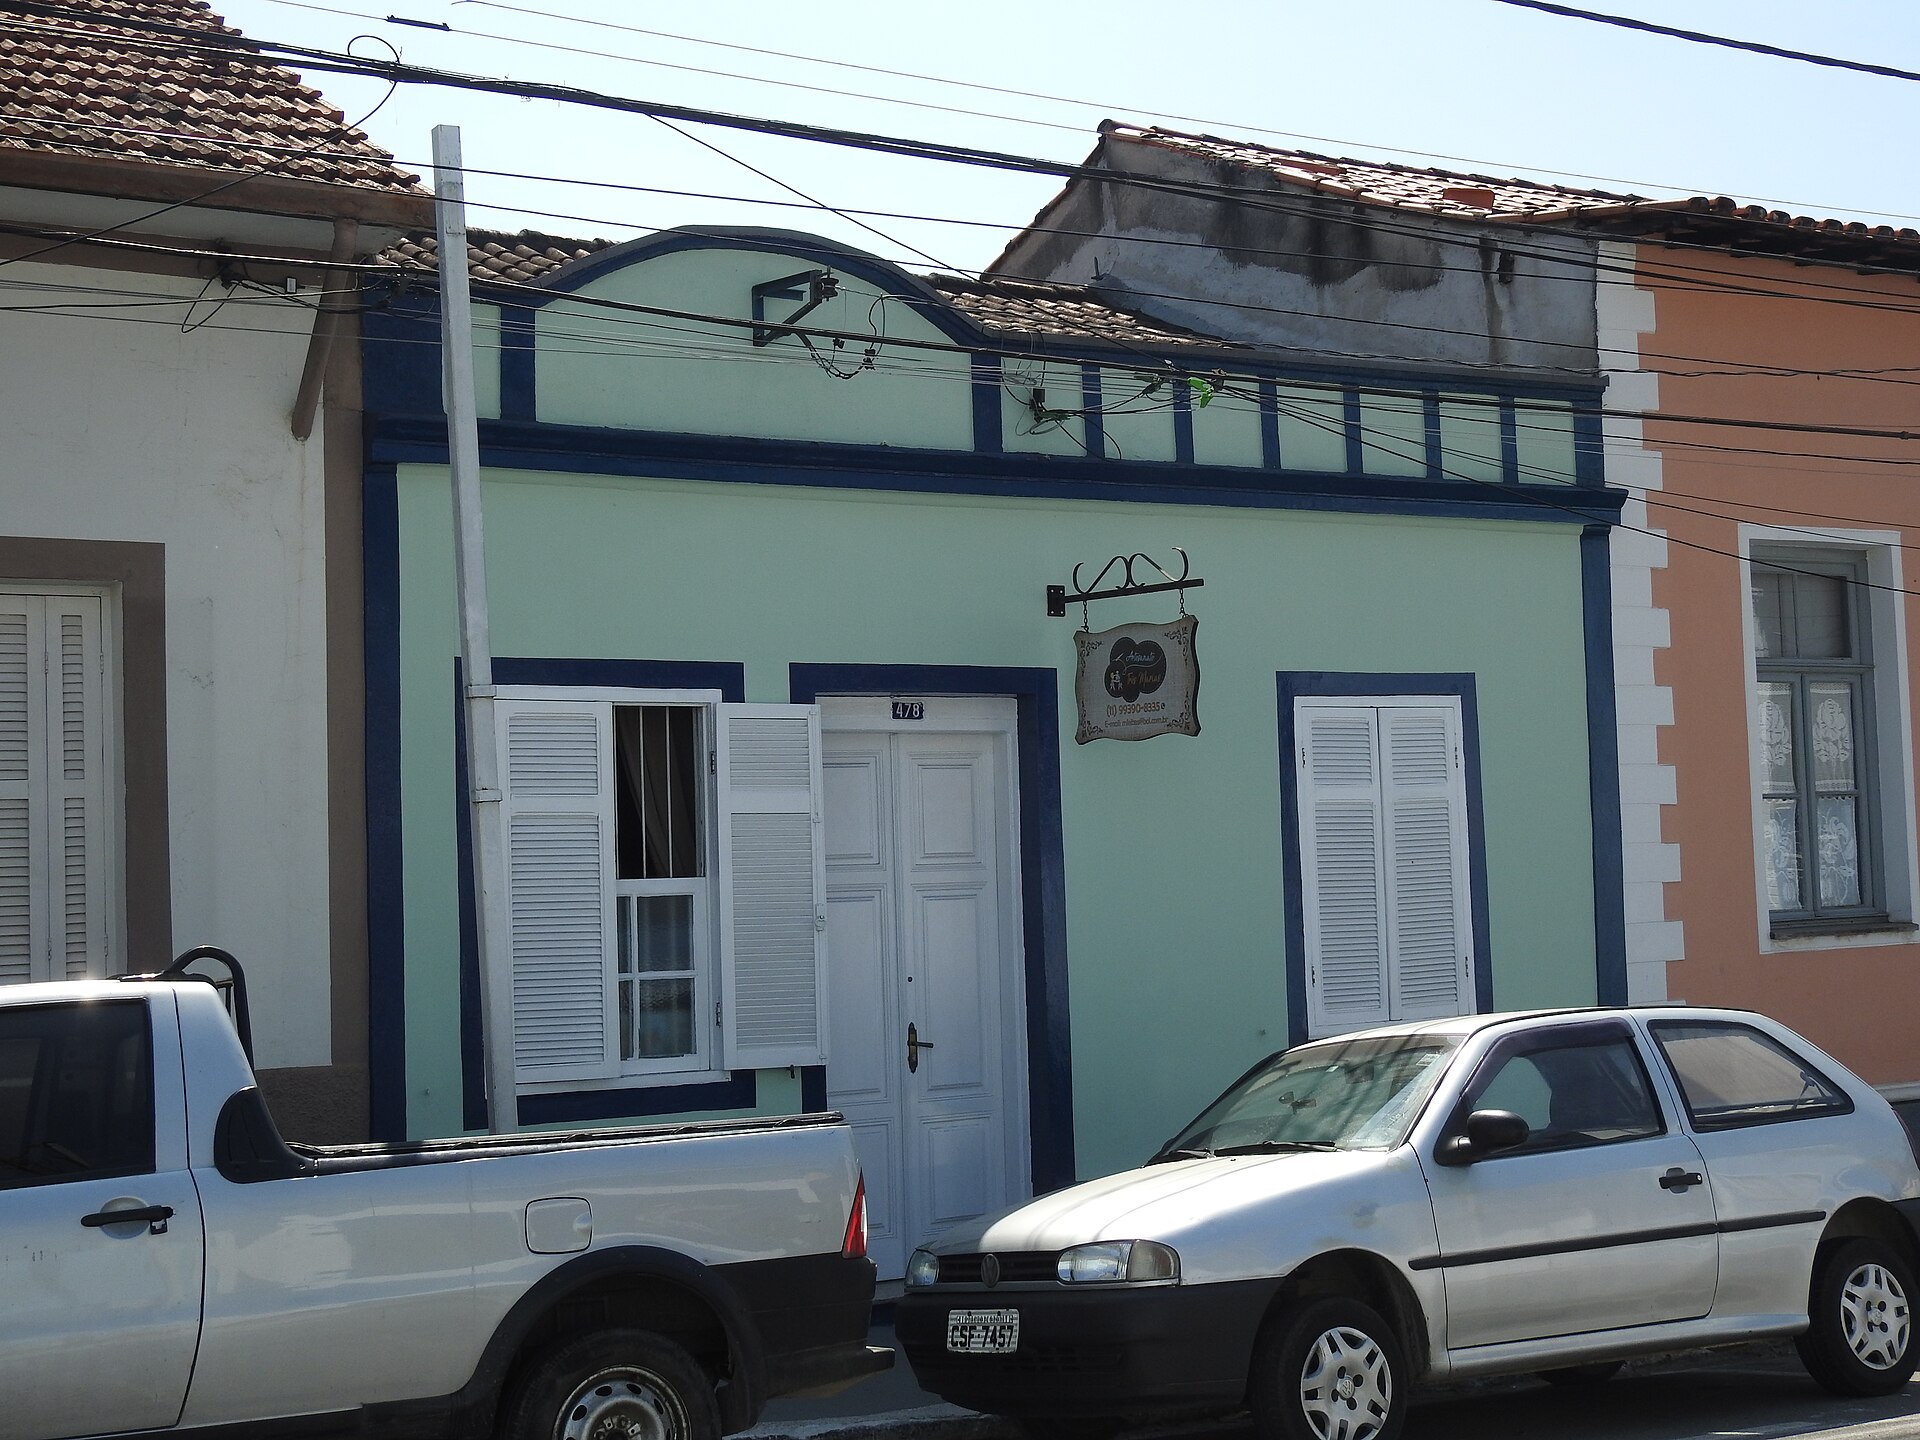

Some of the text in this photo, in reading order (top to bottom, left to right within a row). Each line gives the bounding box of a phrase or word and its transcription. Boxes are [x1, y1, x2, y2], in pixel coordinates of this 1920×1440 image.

[896, 703, 920, 718] 478
[1119, 702, 1160, 714] 99390-8335
[950, 1325, 1014, 1348] CSF-7457
